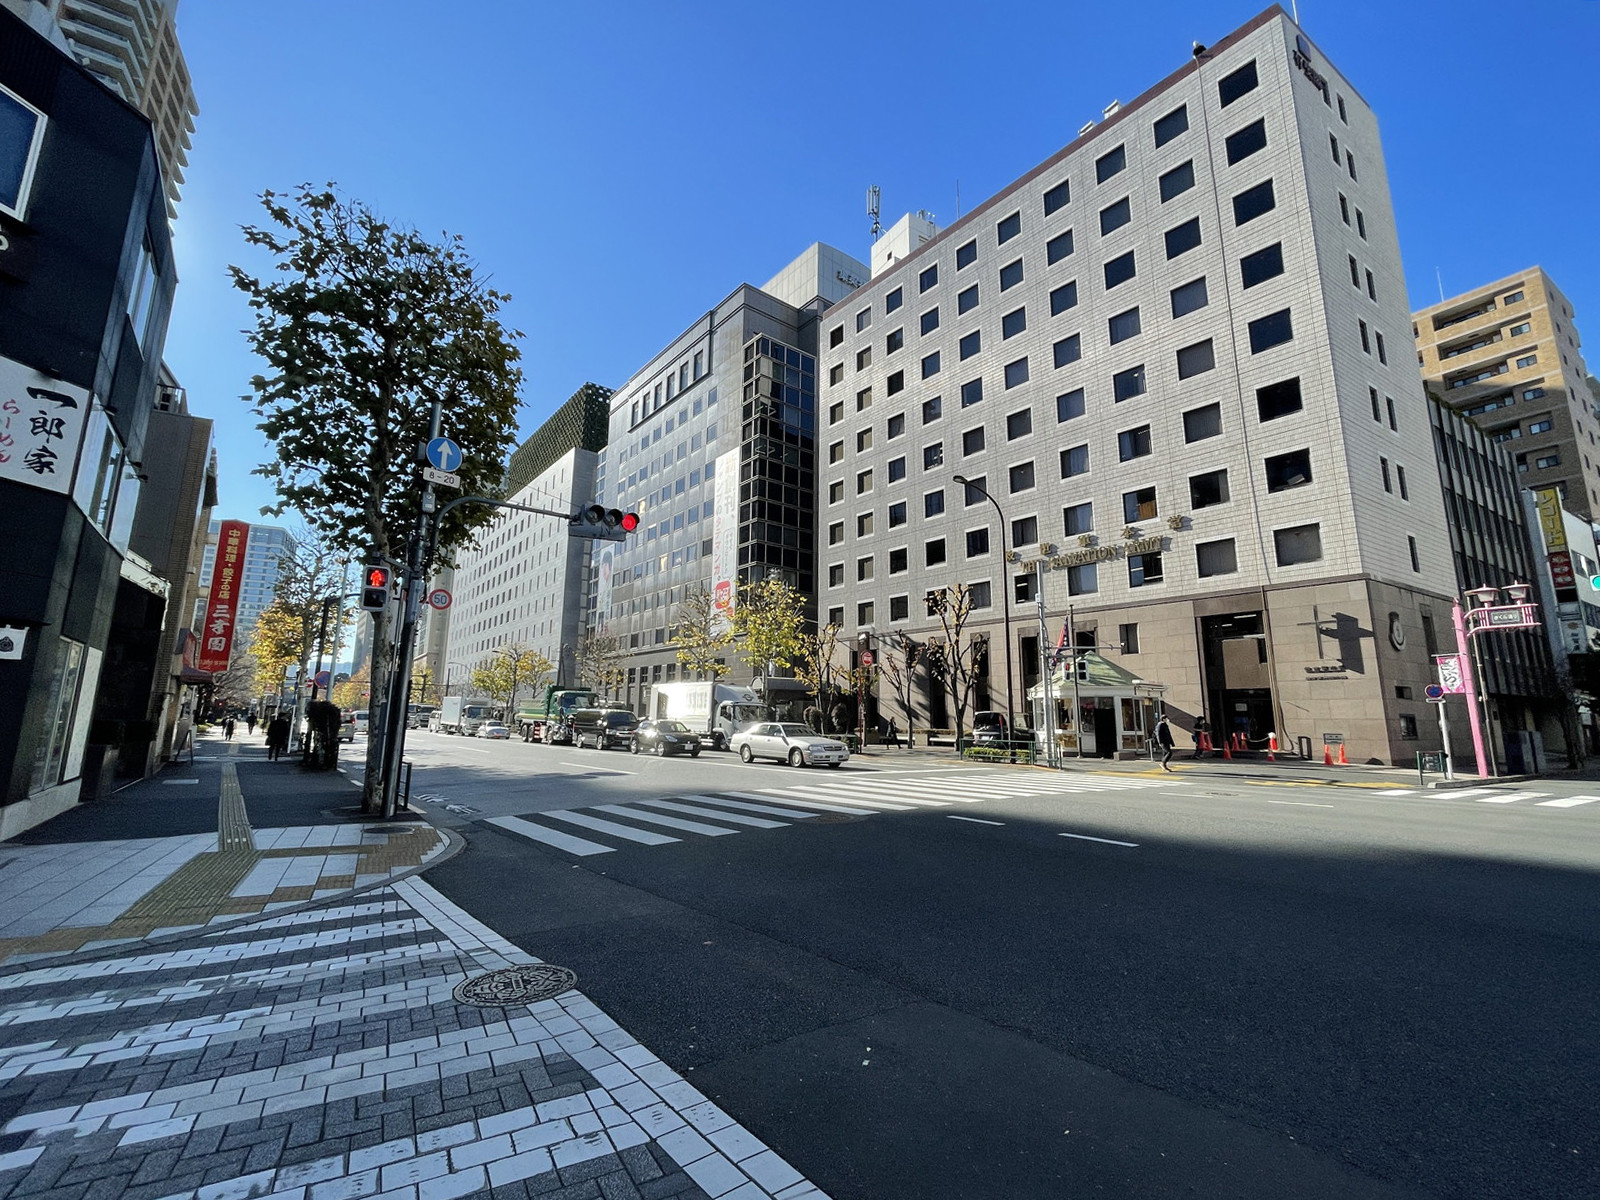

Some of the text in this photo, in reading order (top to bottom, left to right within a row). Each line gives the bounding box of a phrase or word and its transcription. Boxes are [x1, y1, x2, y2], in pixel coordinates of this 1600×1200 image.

[22, 386, 78, 474] 一郎家
[218, 529, 241, 599] 中華料理・餃子の店
[1020, 559, 1042, 573] TH
[1124, 535, 1163, 554] ARMY
[434, 594, 447, 604] 50
